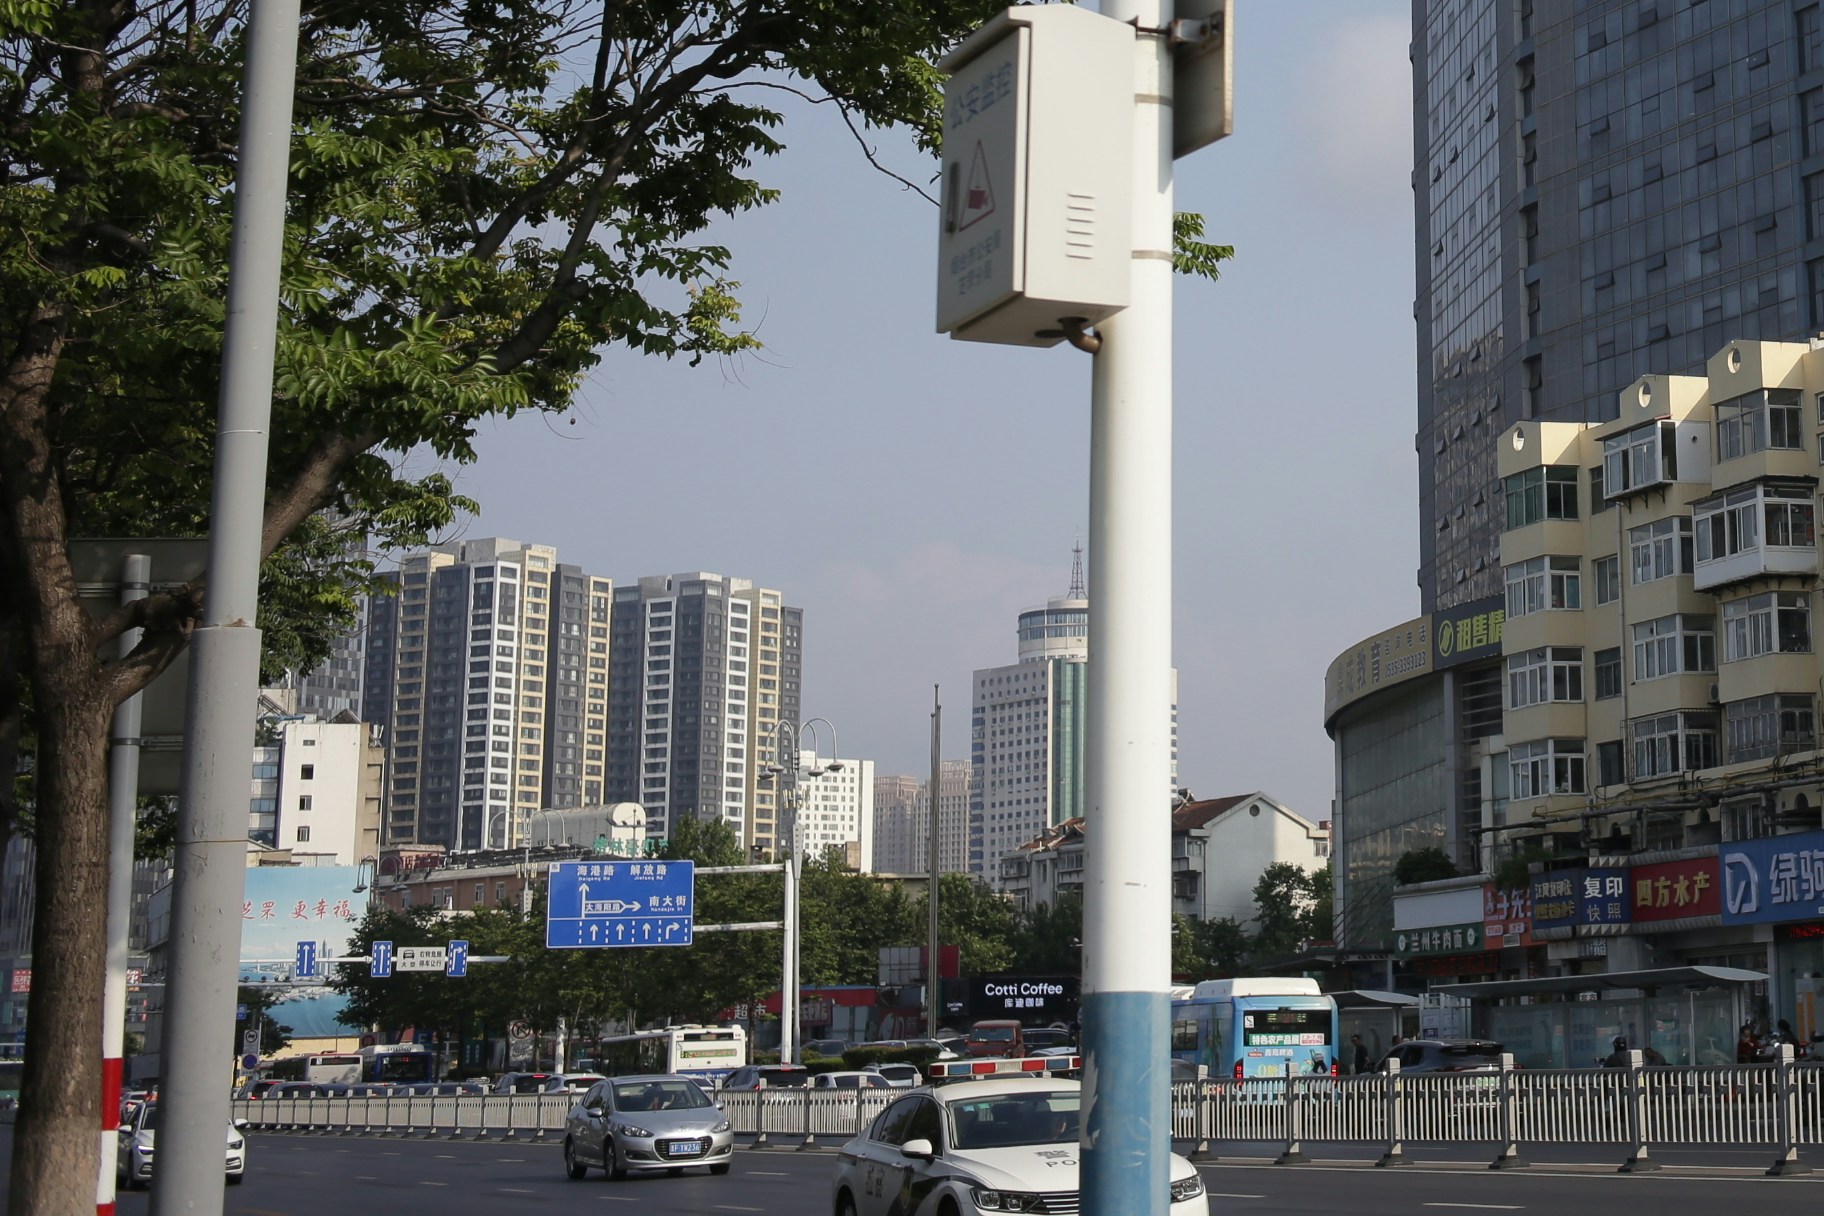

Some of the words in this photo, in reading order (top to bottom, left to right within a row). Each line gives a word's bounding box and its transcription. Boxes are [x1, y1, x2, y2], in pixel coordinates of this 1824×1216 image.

[576, 864, 615, 877] 海港路
[629, 863, 668, 876] 解放路
[1583, 876, 1624, 899] 复印
[1636, 870, 1711, 909] 四方水产
[291, 897, 351, 921] 更幸福
[649, 895, 687, 907] 南大街
[1586, 901, 1623, 922] 快照
[1410, 928, 1464, 953] 兰州牛肉面
[418, 959, 442, 968] 停车让行
[984, 983, 1018, 996] Cotti
[1020, 982, 1063, 995] Coffee
[1251, 1033, 1300, 1046] 特色农产品展
